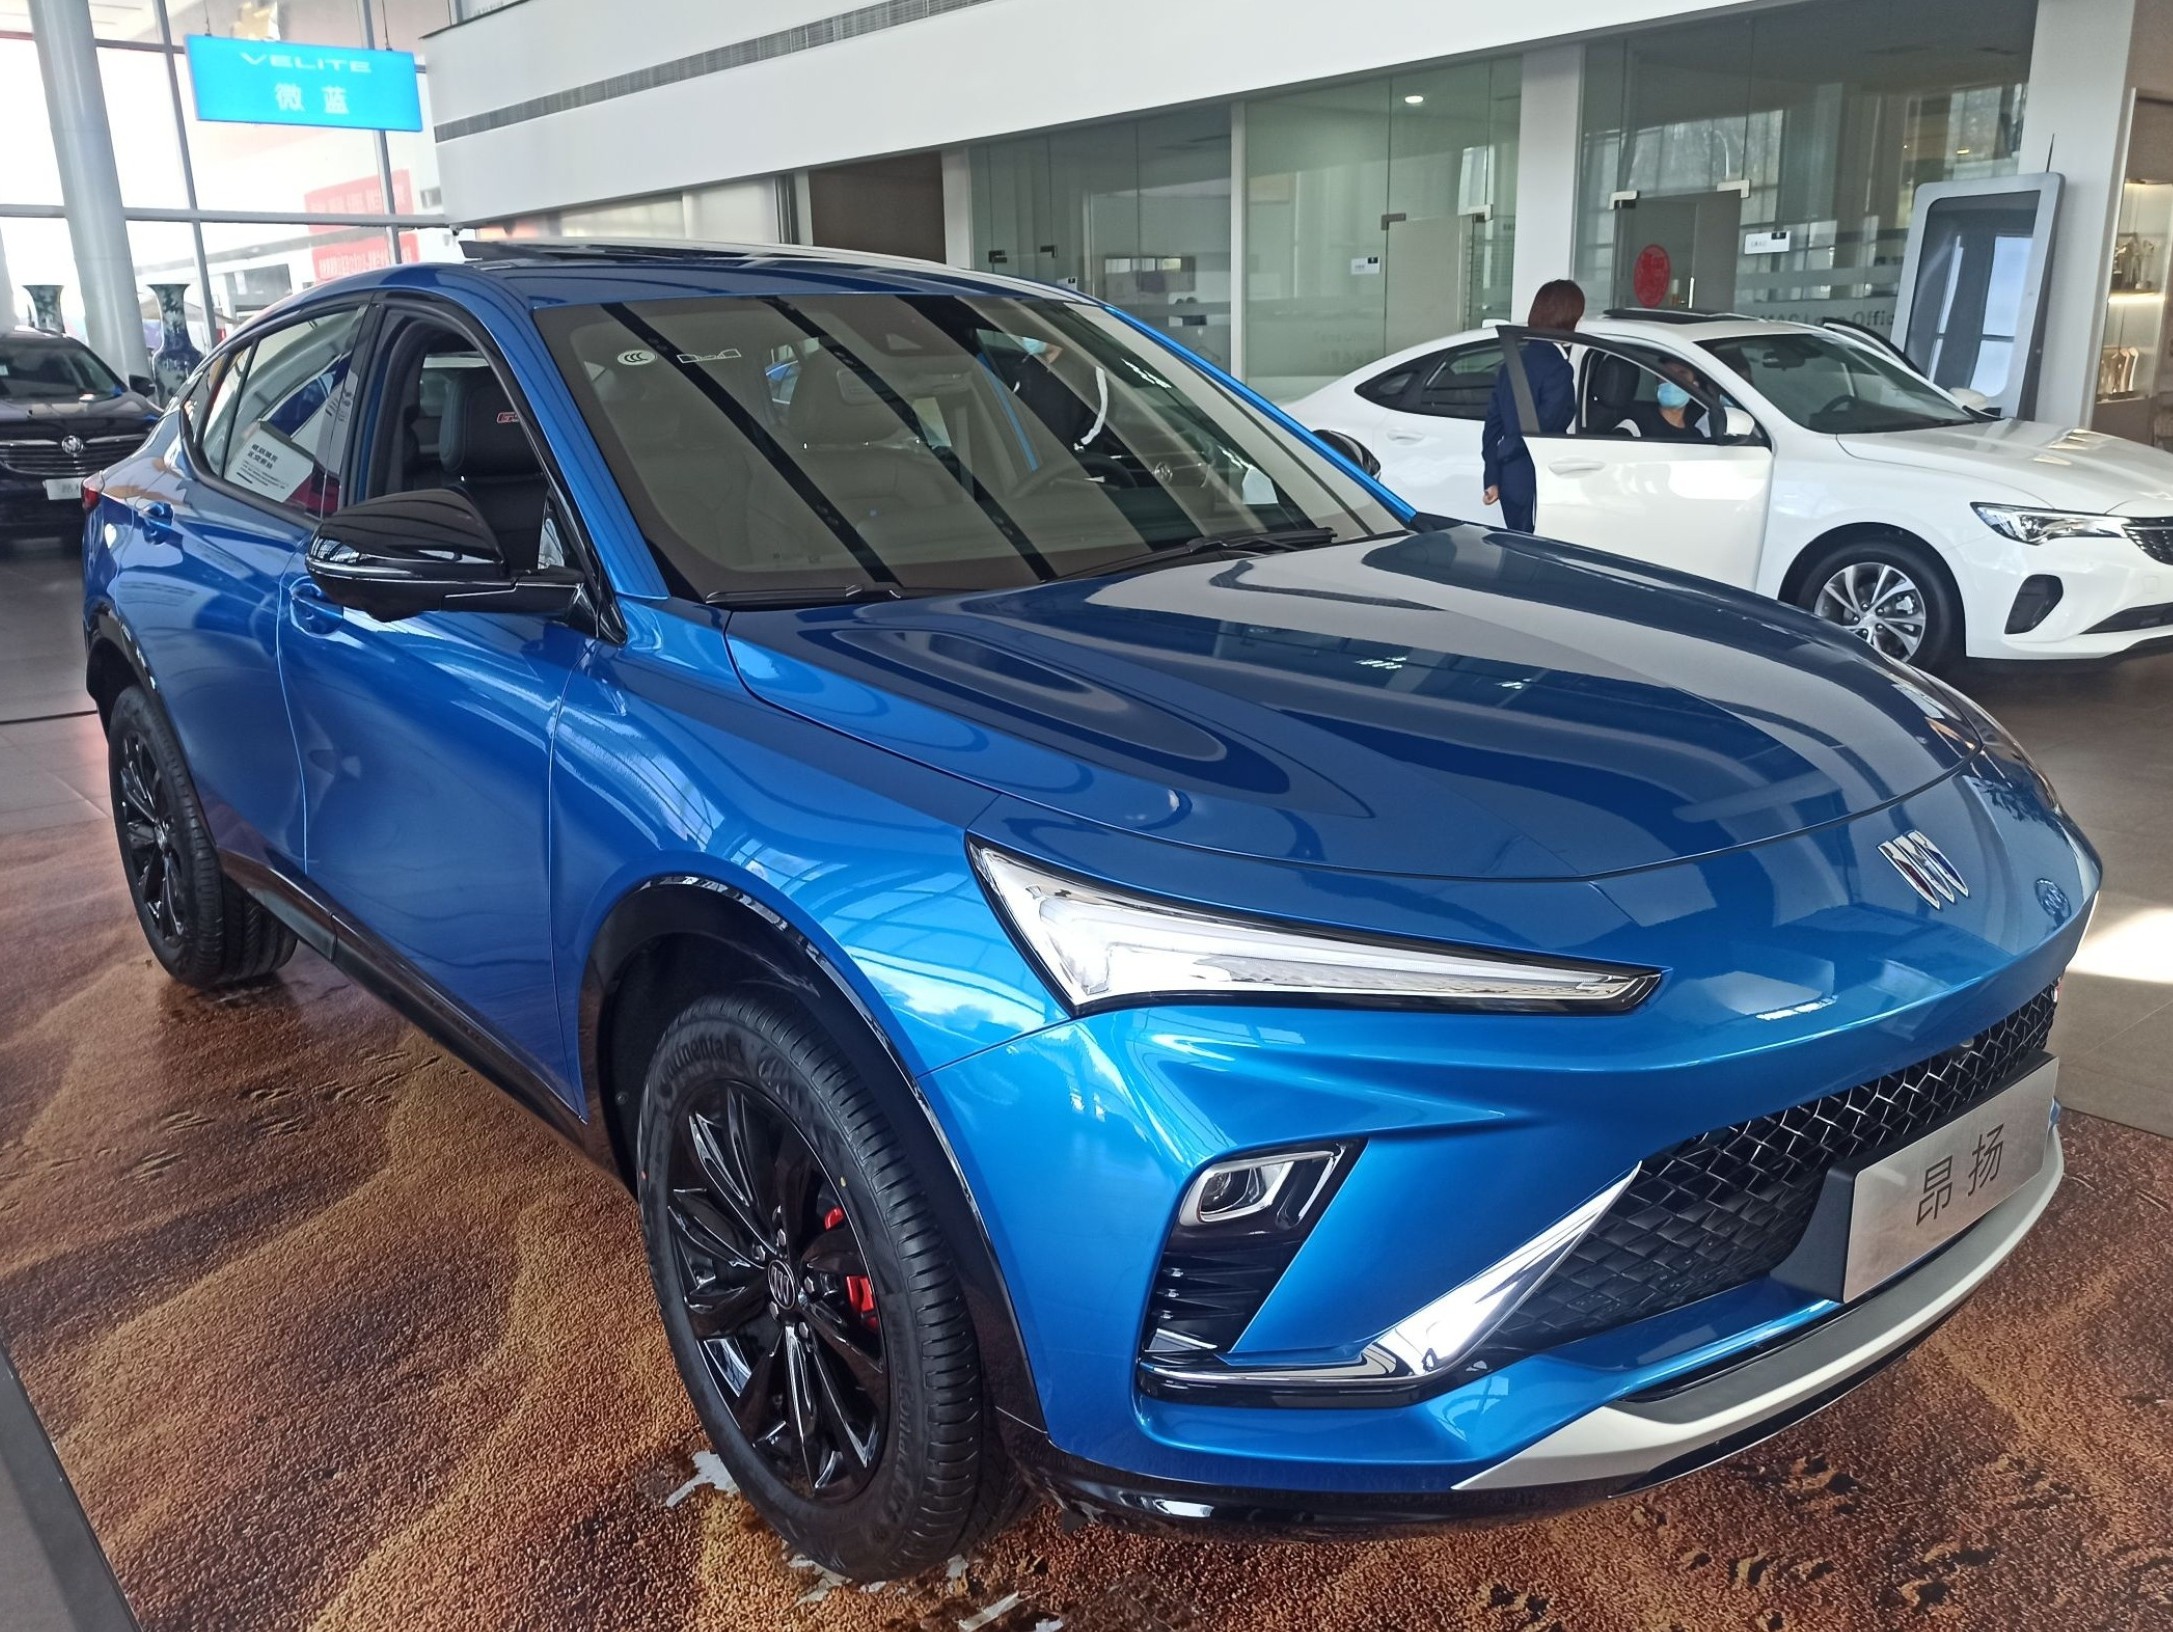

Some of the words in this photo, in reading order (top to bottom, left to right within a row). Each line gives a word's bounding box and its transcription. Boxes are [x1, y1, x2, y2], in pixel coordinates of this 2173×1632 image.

[239, 52, 372, 73] VELITE
[275, 83, 349, 114] 微蓝
[1916, 1122, 2004, 1227] 昂扬
